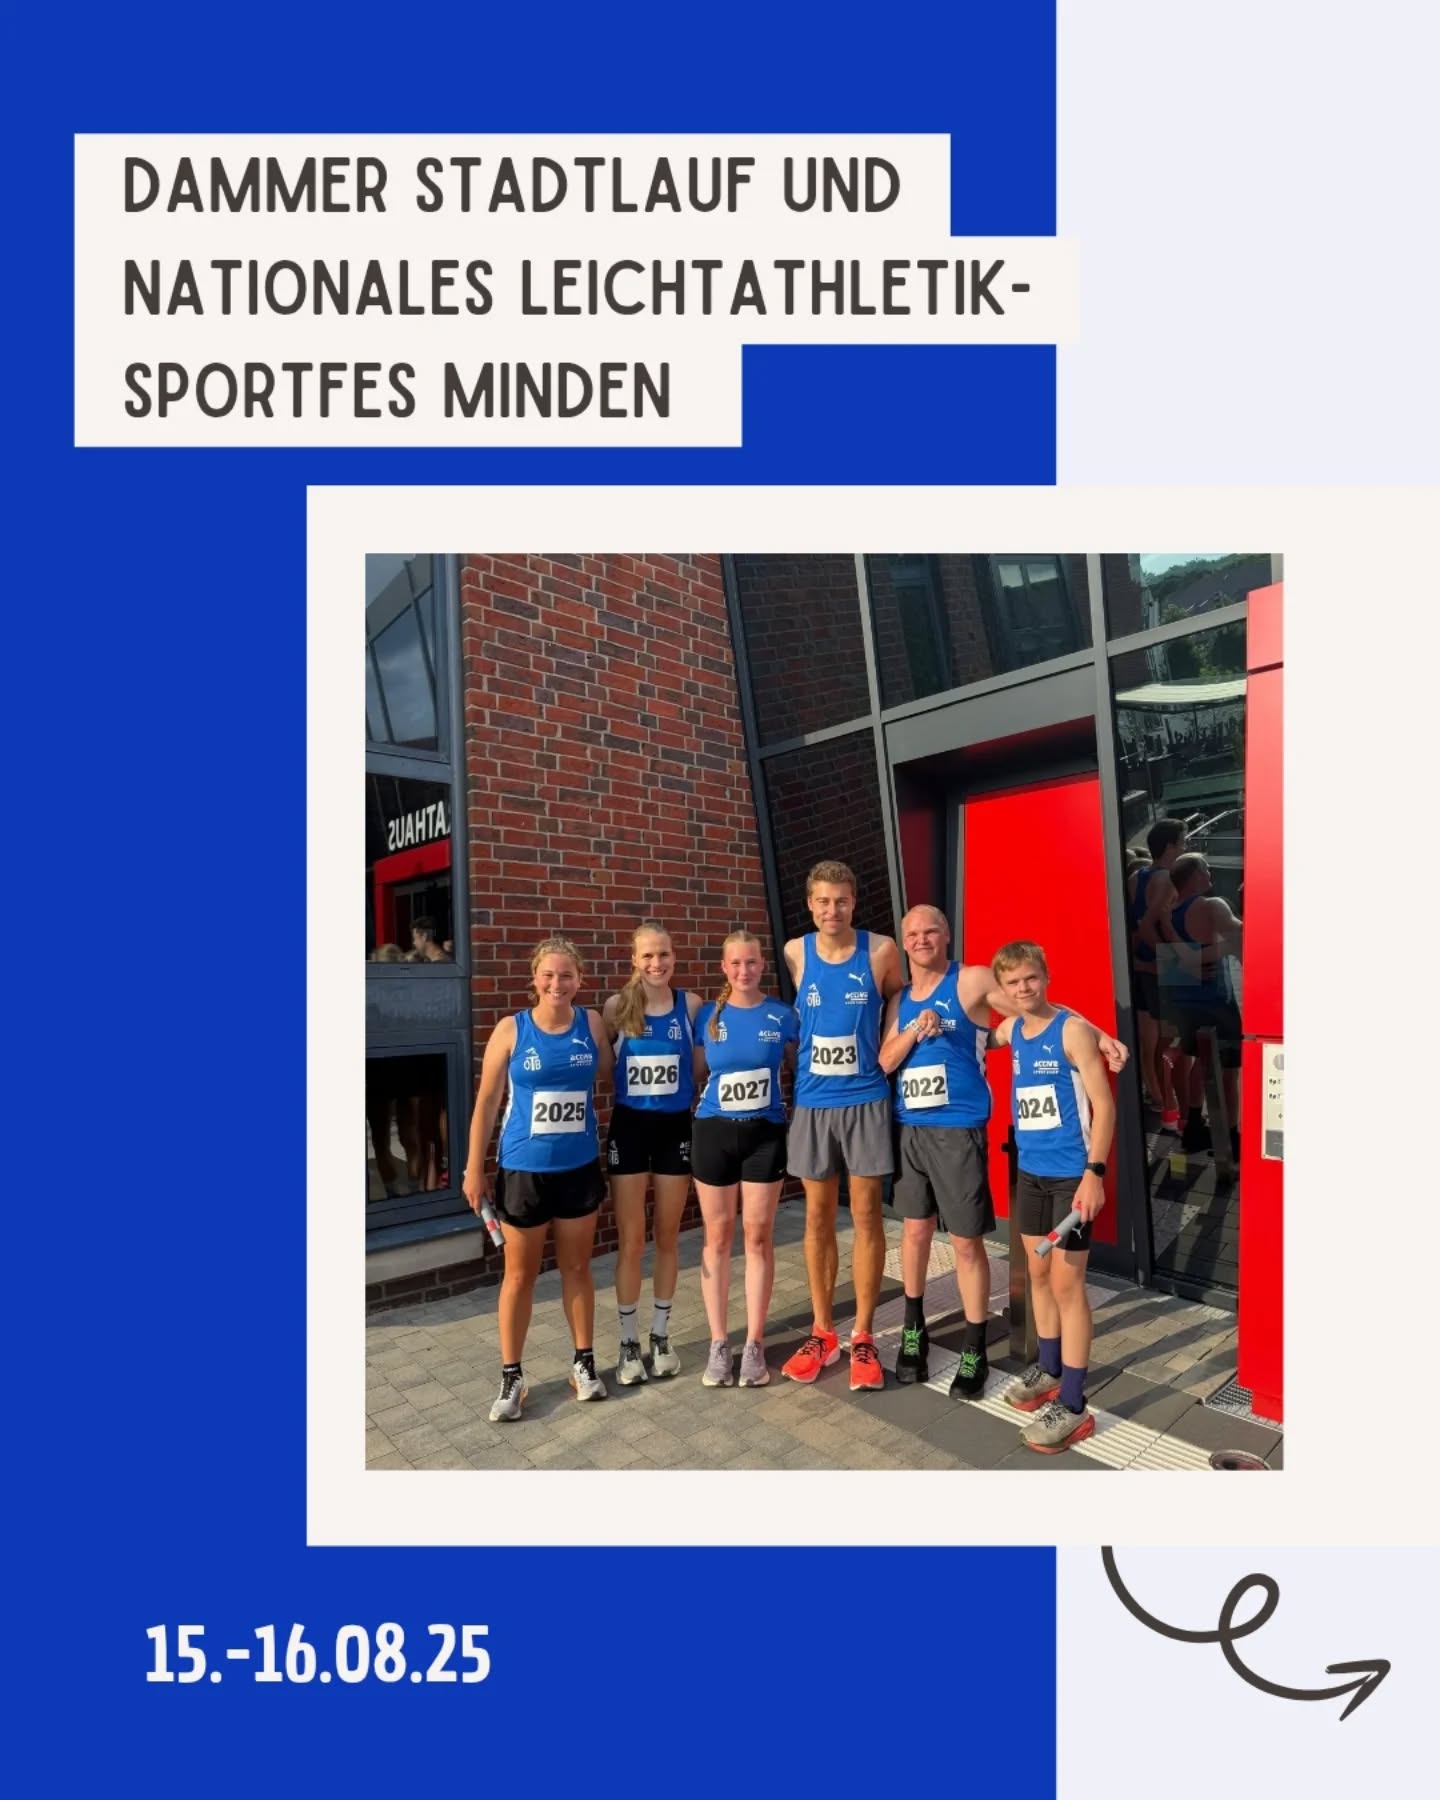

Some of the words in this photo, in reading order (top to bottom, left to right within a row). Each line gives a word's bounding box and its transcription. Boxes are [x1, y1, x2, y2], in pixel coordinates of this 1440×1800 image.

[812, 1046, 857, 1065] 2023
[629, 1065, 678, 1085] 2026
[721, 1079, 769, 1102] 2027
[903, 1075, 946, 1098] 2022
[534, 1102, 585, 1122] 2025
